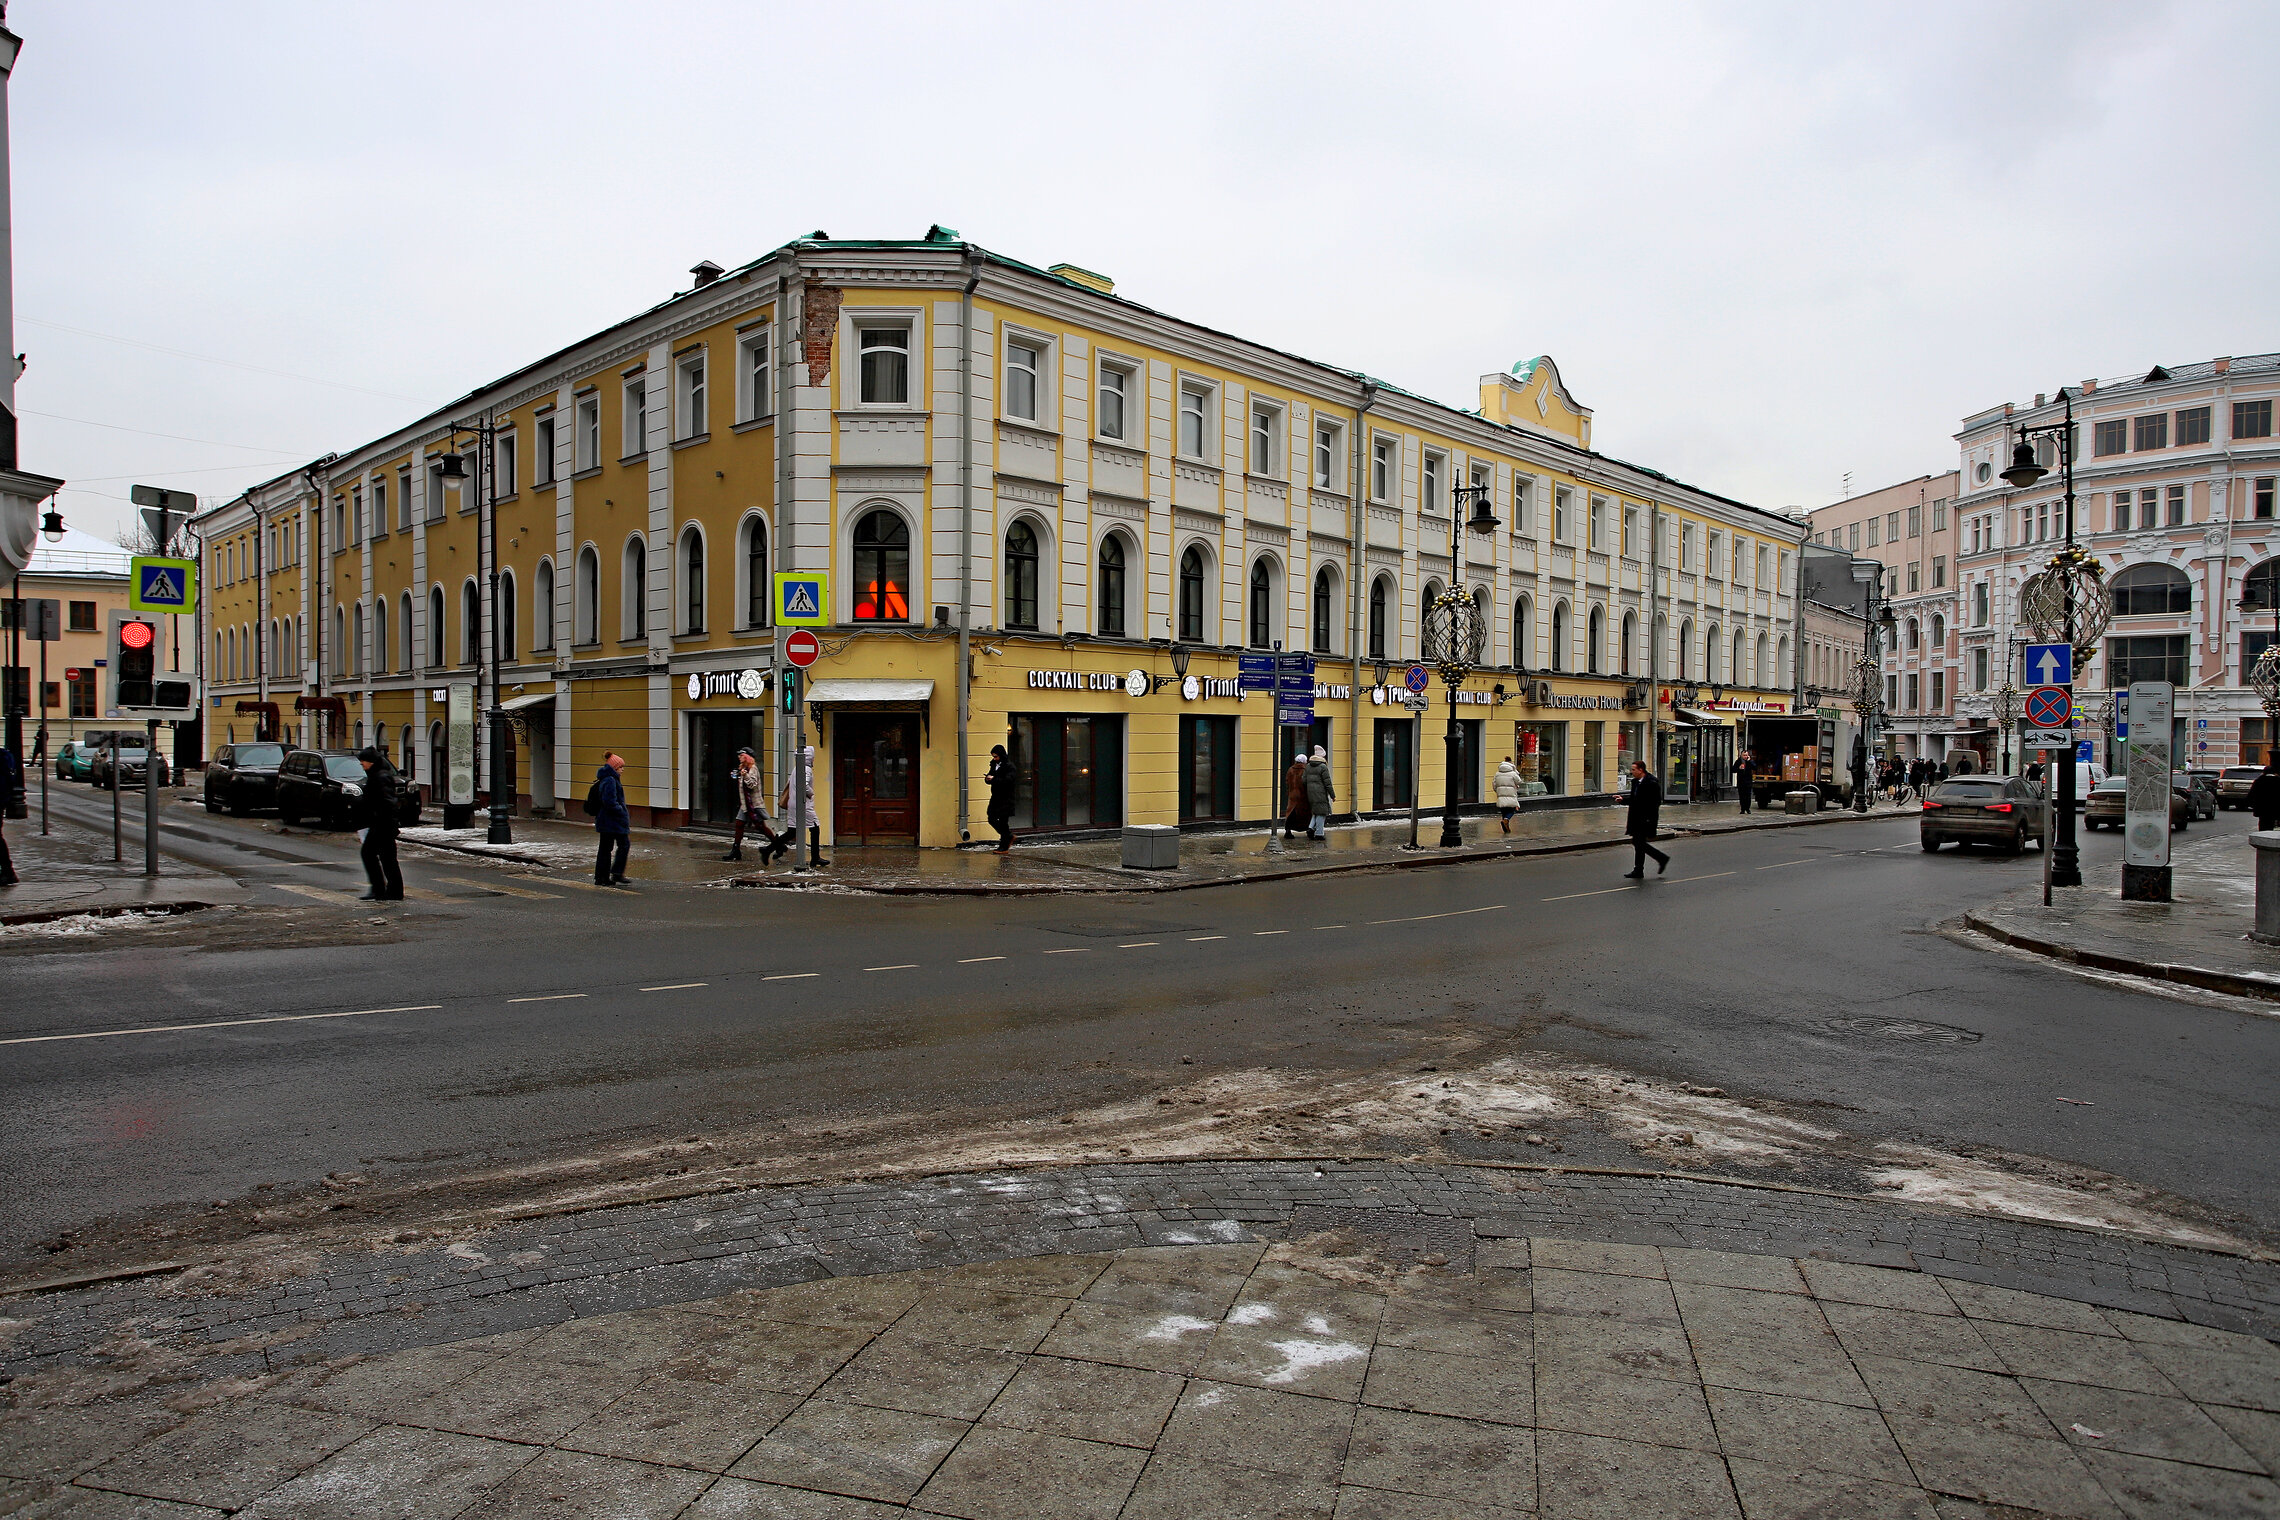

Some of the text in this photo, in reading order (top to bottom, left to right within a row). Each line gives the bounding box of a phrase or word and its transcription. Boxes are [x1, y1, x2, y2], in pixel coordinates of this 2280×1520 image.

[703, 672, 740, 699] Trinit
[784, 672, 795, 687] 47
[1029, 670, 1117, 690] COCKTAIL CLUB
[1331, 685, 1350, 699] КЛУБ
[1447, 690, 1492, 704] CCKTAIL CLUB
[1545, 693, 1598, 709] ÜCHENLAND
